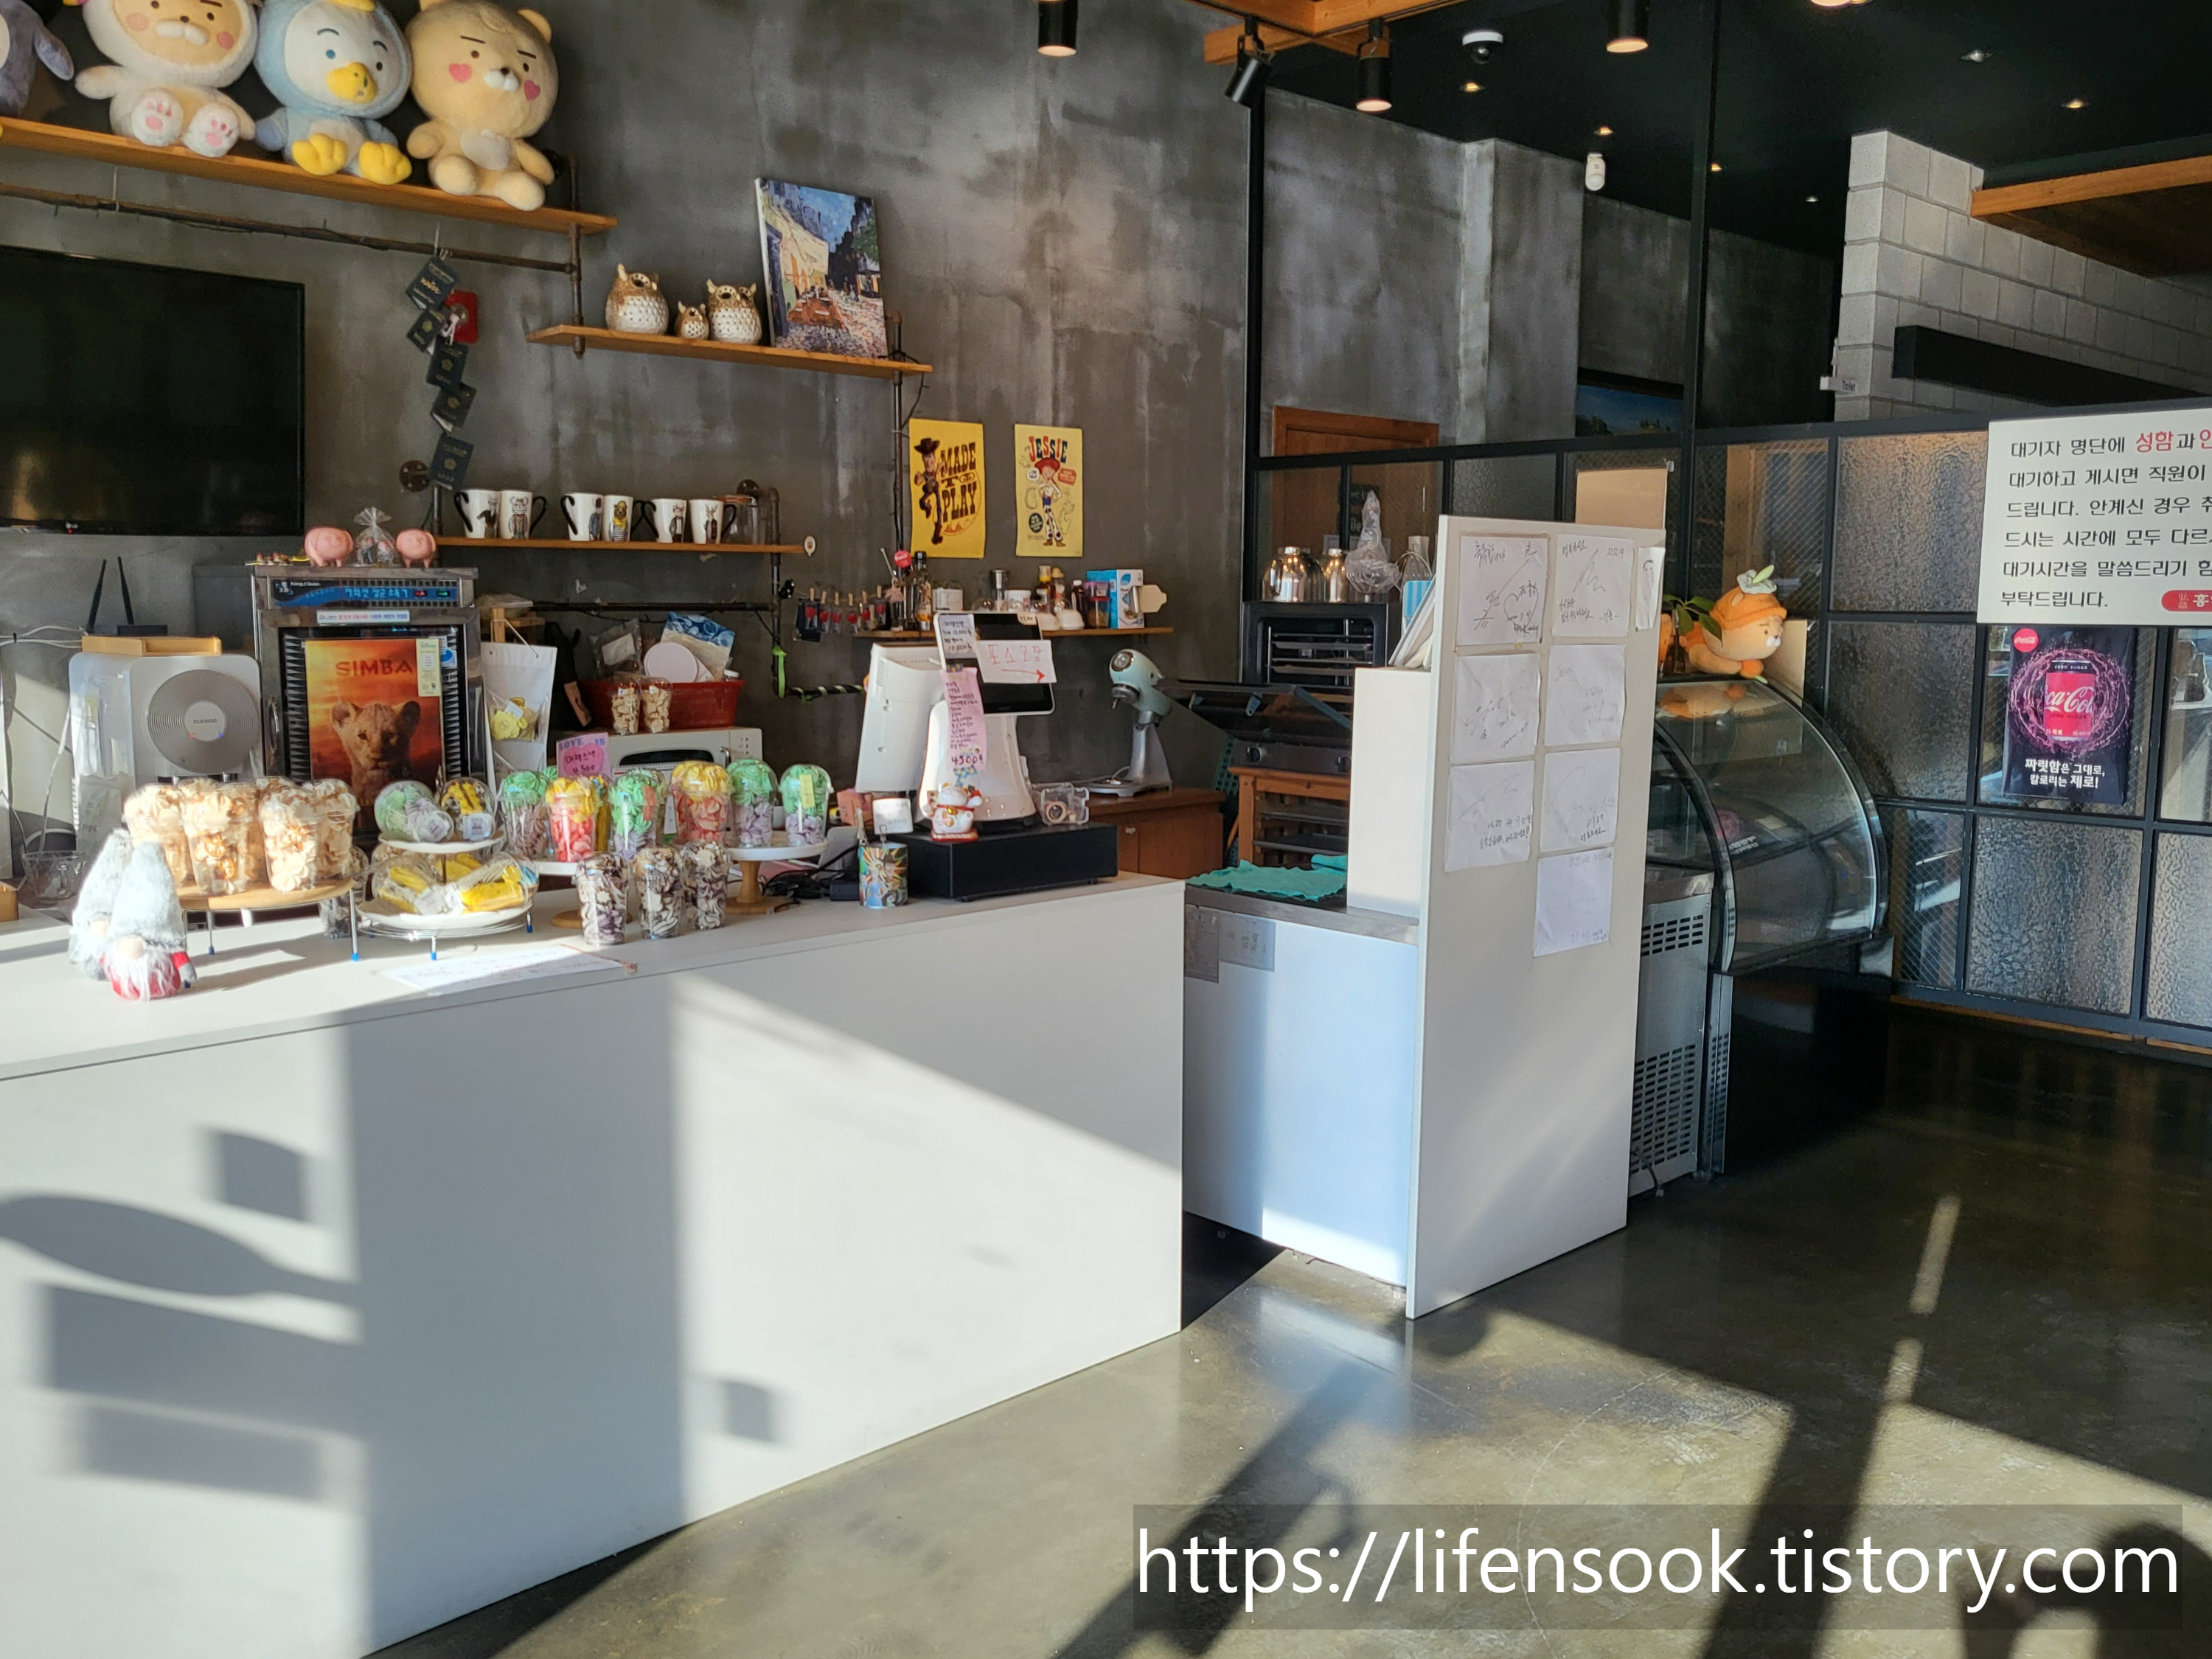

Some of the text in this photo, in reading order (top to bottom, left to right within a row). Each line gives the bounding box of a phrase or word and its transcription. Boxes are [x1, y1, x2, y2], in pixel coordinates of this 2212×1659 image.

[1028, 435, 1068, 464] JESSIE
[2011, 440, 2061, 458] 대기자
[2070, 437, 2125, 456] 명단에
[940, 442, 977, 478] MADE
[2009, 470, 2076, 488] 대기하고
[2148, 464, 2206, 483] 직원이
[942, 481, 978, 524] PLAY
[2008, 501, 2079, 518] 드립니다.
[2090, 498, 2144, 516] 안계신
[2154, 496, 2191, 515] 경우
[2005, 528, 2212, 547] 드시는 시간에 모두 다르
[2003, 561, 2087, 577] 대기시간을
[2098, 560, 2187, 577] 말씀드리기
[2002, 591, 2108, 608] 부탁드립니다.
[2192, 594, 2212, 608] 홍
[336, 658, 414, 678] SIMBA
[2025, 758, 2070, 772] 짜릿함은
[2030, 773, 2099, 788] 칼로리는 제로!
